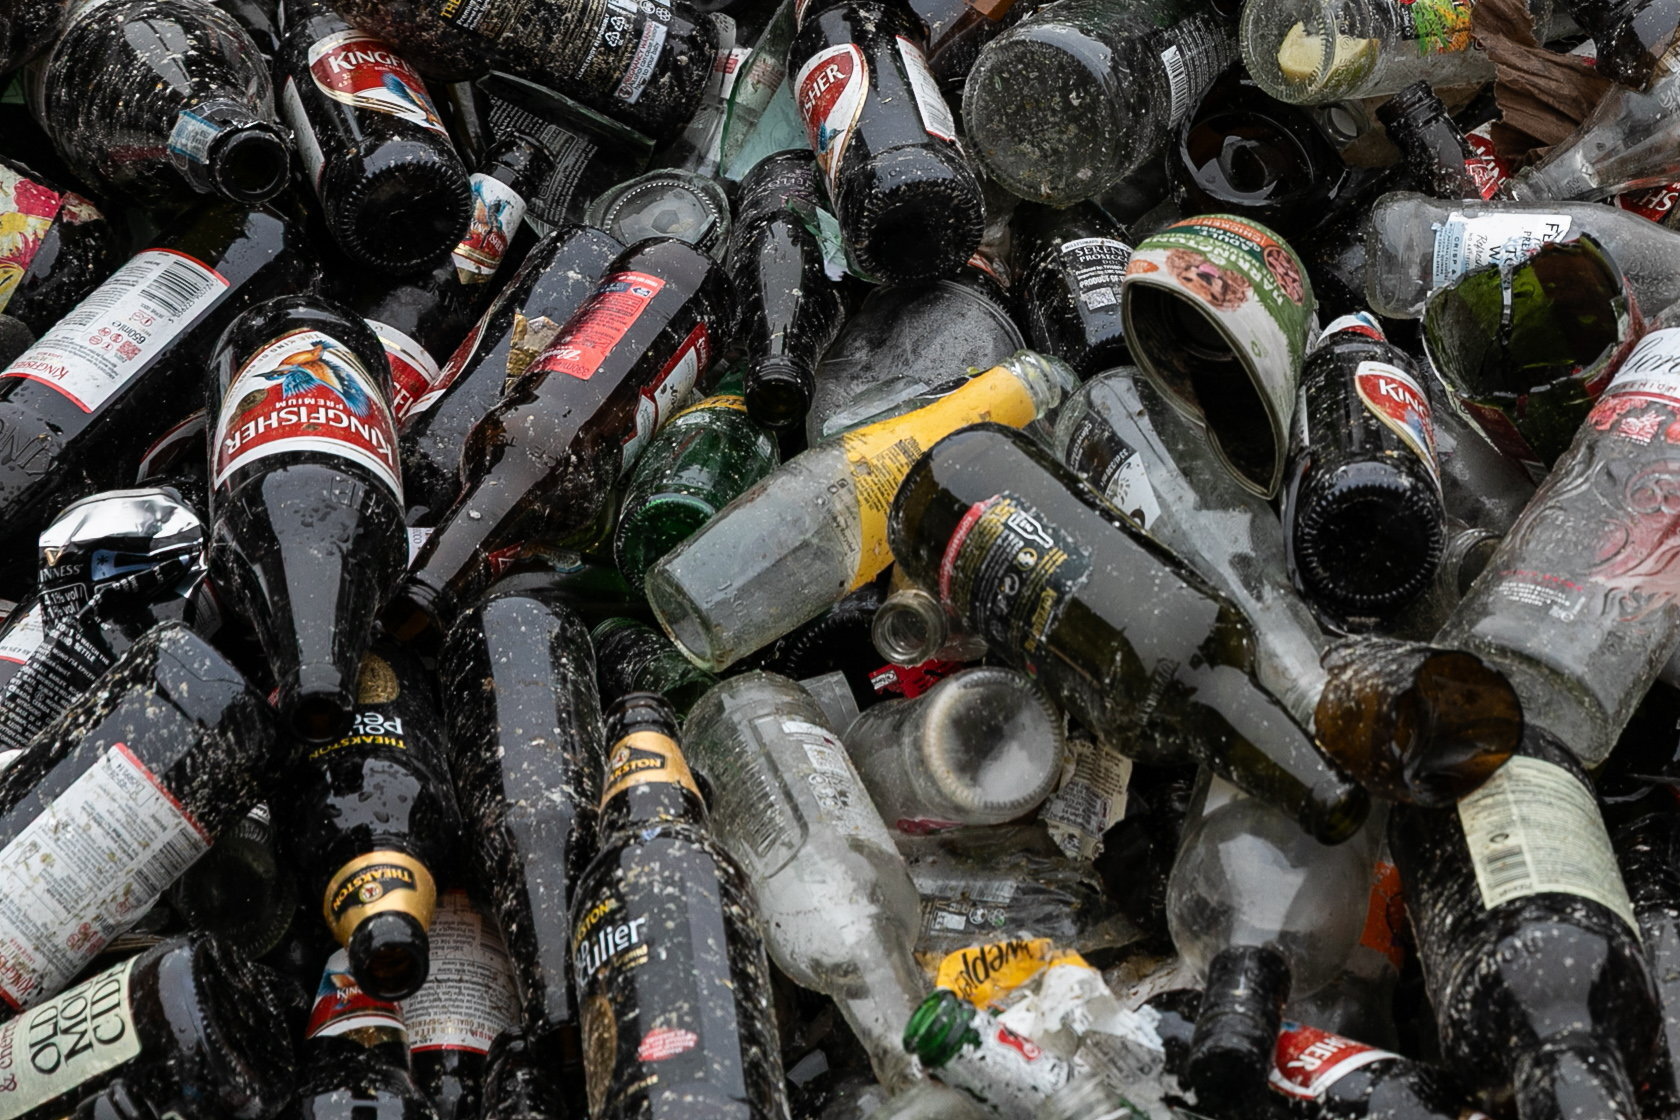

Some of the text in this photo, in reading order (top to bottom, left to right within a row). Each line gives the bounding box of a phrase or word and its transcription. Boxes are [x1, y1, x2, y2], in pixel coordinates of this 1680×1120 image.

[276, 396, 344, 412] PREMIUM
[223, 409, 397, 467] KINGFISHER
[72, 642, 96, 663] SETTLE
[308, 734, 408, 760] THEAKSTON
[331, 866, 413, 910] THEAKSTON
[30, 1004, 62, 1076] OLD
